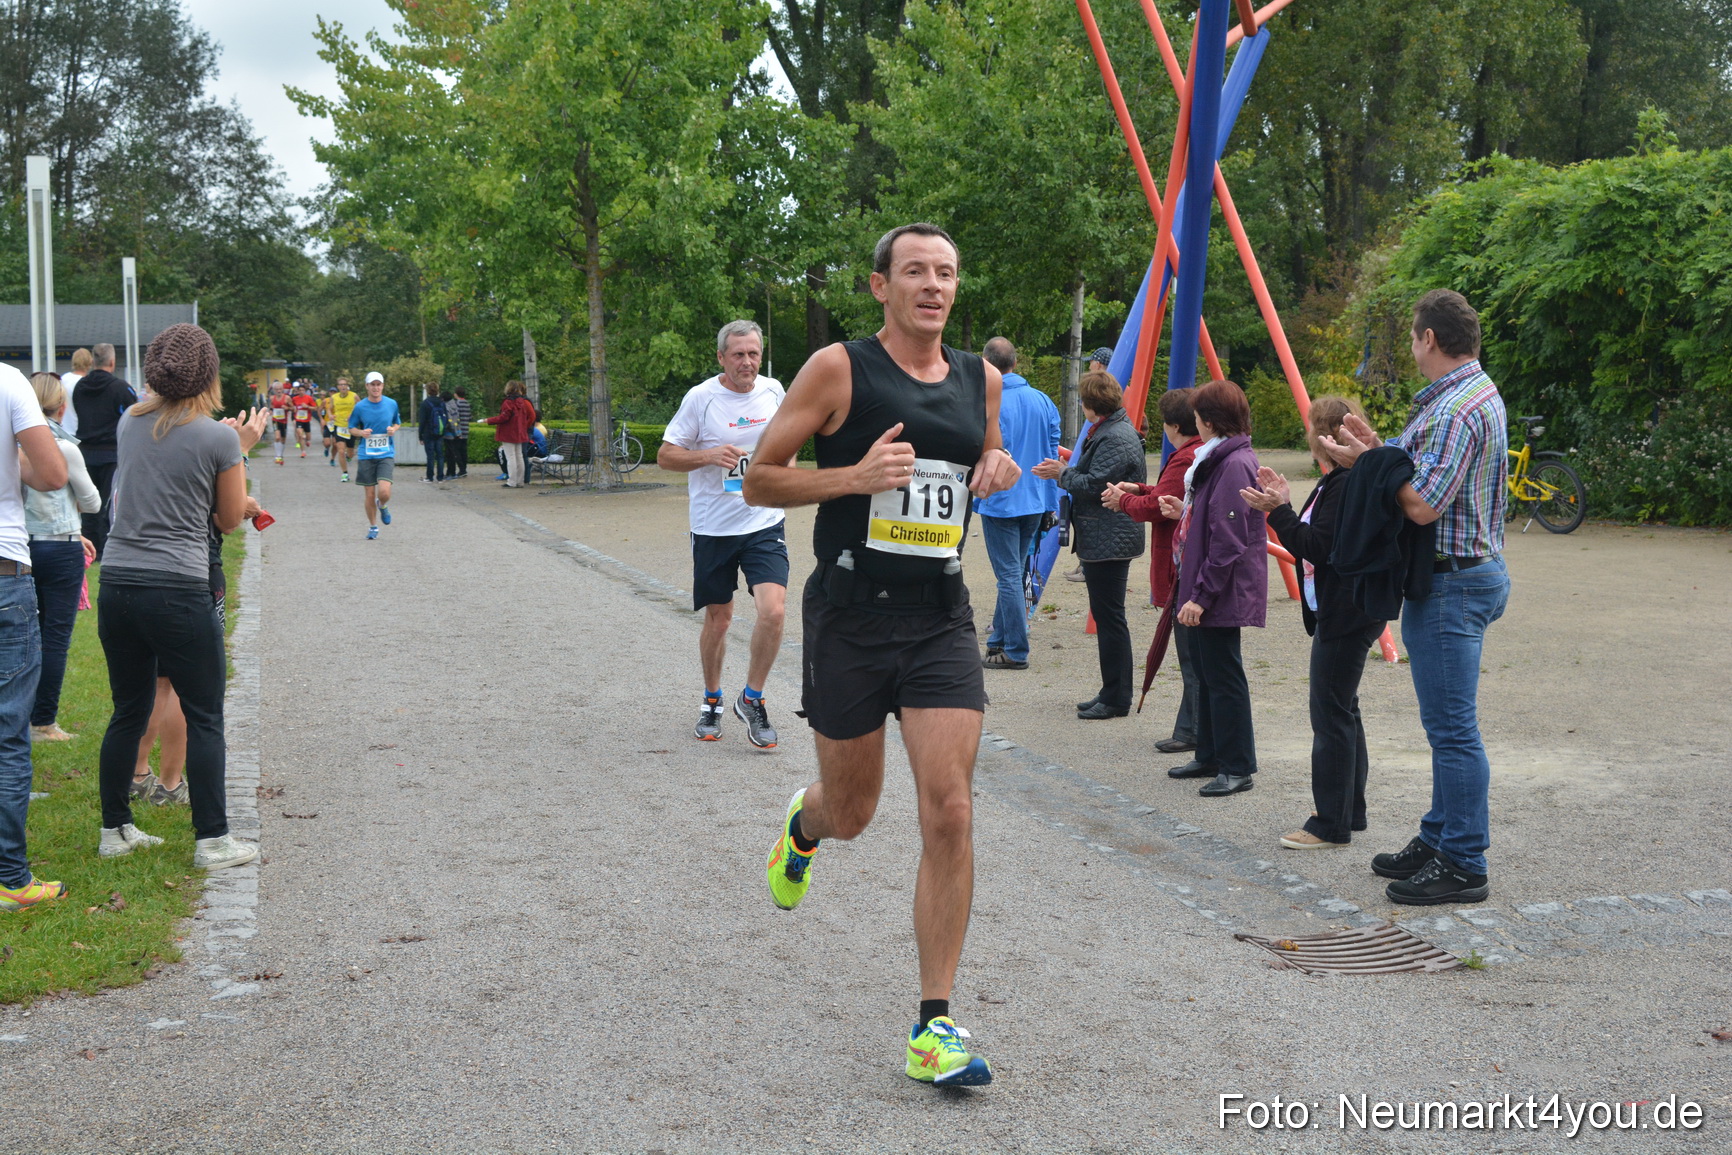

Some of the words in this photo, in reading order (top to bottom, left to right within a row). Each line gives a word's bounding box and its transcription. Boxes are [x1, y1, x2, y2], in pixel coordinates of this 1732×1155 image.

[368, 438, 387, 447] 2120
[912, 468, 956, 480] Neumar
[896, 483, 954, 520] 119
[890, 525, 951, 547] Christoph
